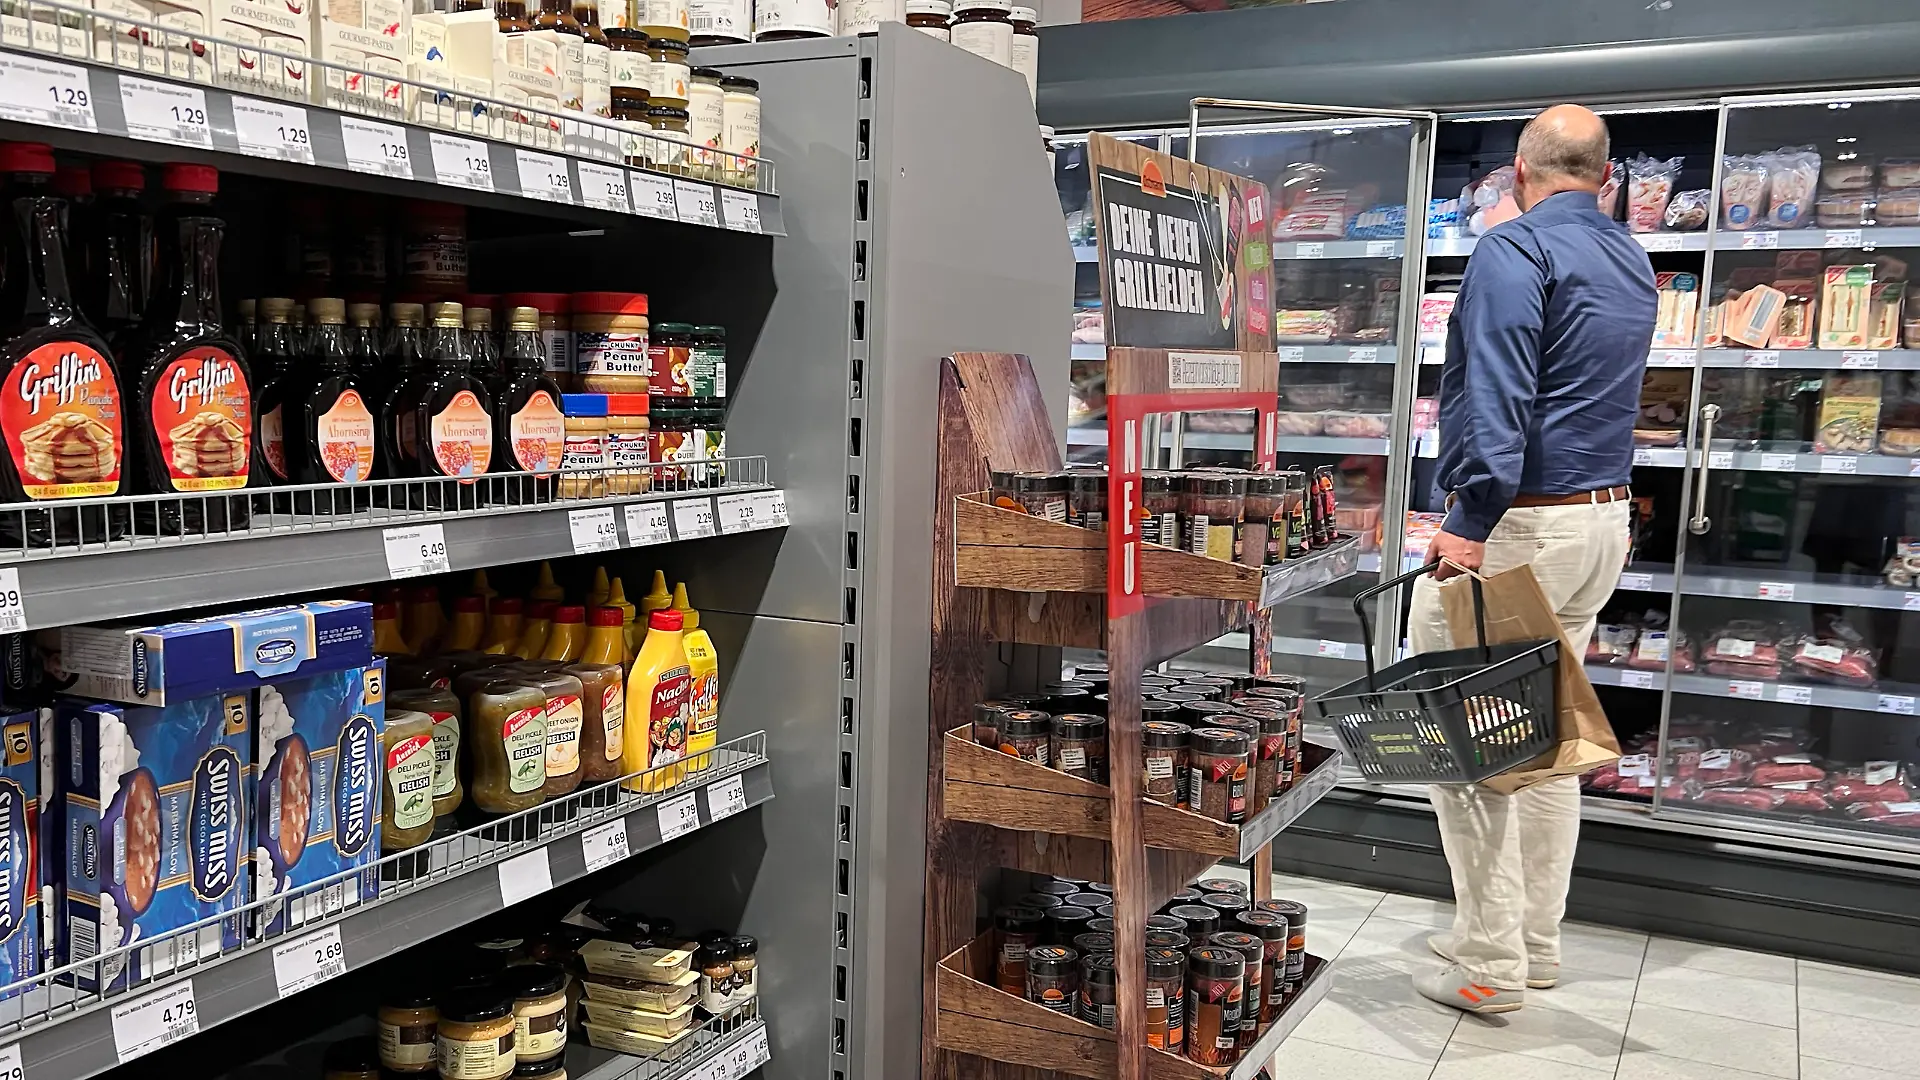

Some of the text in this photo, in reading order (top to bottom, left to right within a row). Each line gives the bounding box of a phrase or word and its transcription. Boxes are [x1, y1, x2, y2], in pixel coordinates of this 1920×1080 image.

[231, 4, 296, 29] GOURMET-PASTEN
[339, 30, 394, 51] GOURMET-PASTEN
[49, 86, 88, 107] 1.29
[171, 106, 205, 125] 1.29
[277, 126, 308, 144] 1.29
[380, 143, 407, 159] 1.29
[465, 157, 488, 172] 1.29
[547, 174, 568, 187] 1.29
[606, 183, 625, 197] 2.29
[656, 191, 673, 204] 2.99
[699, 200, 715, 213] 2.99
[743, 207, 758, 220] 2.79
[1247, 195, 1263, 225] NEU
[1109, 202, 1201, 265] DEINE NEUEN
[1114, 258, 1205, 315] GRILLHELDEN
[603, 351, 644, 361] Peanut
[606, 361, 642, 372] Butter
[19, 352, 103, 415] Griffin's
[170, 357, 236, 415] Griffin's
[327, 424, 370, 440] Ahornsirup
[440, 424, 487, 441] Ahornsirup
[519, 423, 561, 440] Ahornsirup
[563, 454, 603, 464] Peanut
[613, 451, 647, 461] Peanut
[32, 488, 43, 496] 24
[739, 507, 754, 518] 2.29
[771, 503, 786, 514] 2.29
[1124, 419, 1136, 595] NEU
[650, 516, 667, 528] 4.49
[696, 513, 712, 524] 2.29
[597, 522, 615, 535] 4.49
[421, 542, 444, 557] 6.49
[252, 625, 298, 638] MARSHMALLOW
[136, 641, 148, 696] SWISS MISS
[369, 676, 380, 696] 10
[656, 678, 689, 704] Nacho
[231, 703, 244, 725] 10
[547, 716, 578, 727] EET ONION
[434, 734, 451, 742] CKLE
[525, 729, 542, 739] PICKLE
[547, 732, 573, 745] RELISH
[12, 731, 28, 754] 10
[1266, 738, 1280, 753] NEU
[515, 746, 541, 758] RELISH
[397, 760, 430, 774] DELI PICKLE
[1216, 760, 1232, 775] NEU
[345, 725, 369, 846] SWISS MISS
[401, 777, 429, 792] RELISH
[316, 761, 326, 832] MARSHMALLOW
[727, 787, 743, 801] 3.29
[679, 803, 696, 819] 3.79
[205, 757, 230, 889] SWISS MISS
[169, 796, 179, 876] MARSHMALLOW
[607, 831, 625, 847] 4.69
[85, 827, 96, 876] SWISS MISS
[315, 942, 342, 963] 2.69
[1211, 983, 1226, 998] NEU
[152, 992, 177, 1005] Chocolate
[163, 999, 195, 1023] 4.79
[754, 1038, 767, 1053] 1.49
[732, 1050, 747, 1066] 1.49
[711, 1064, 726, 1080] 1.79
